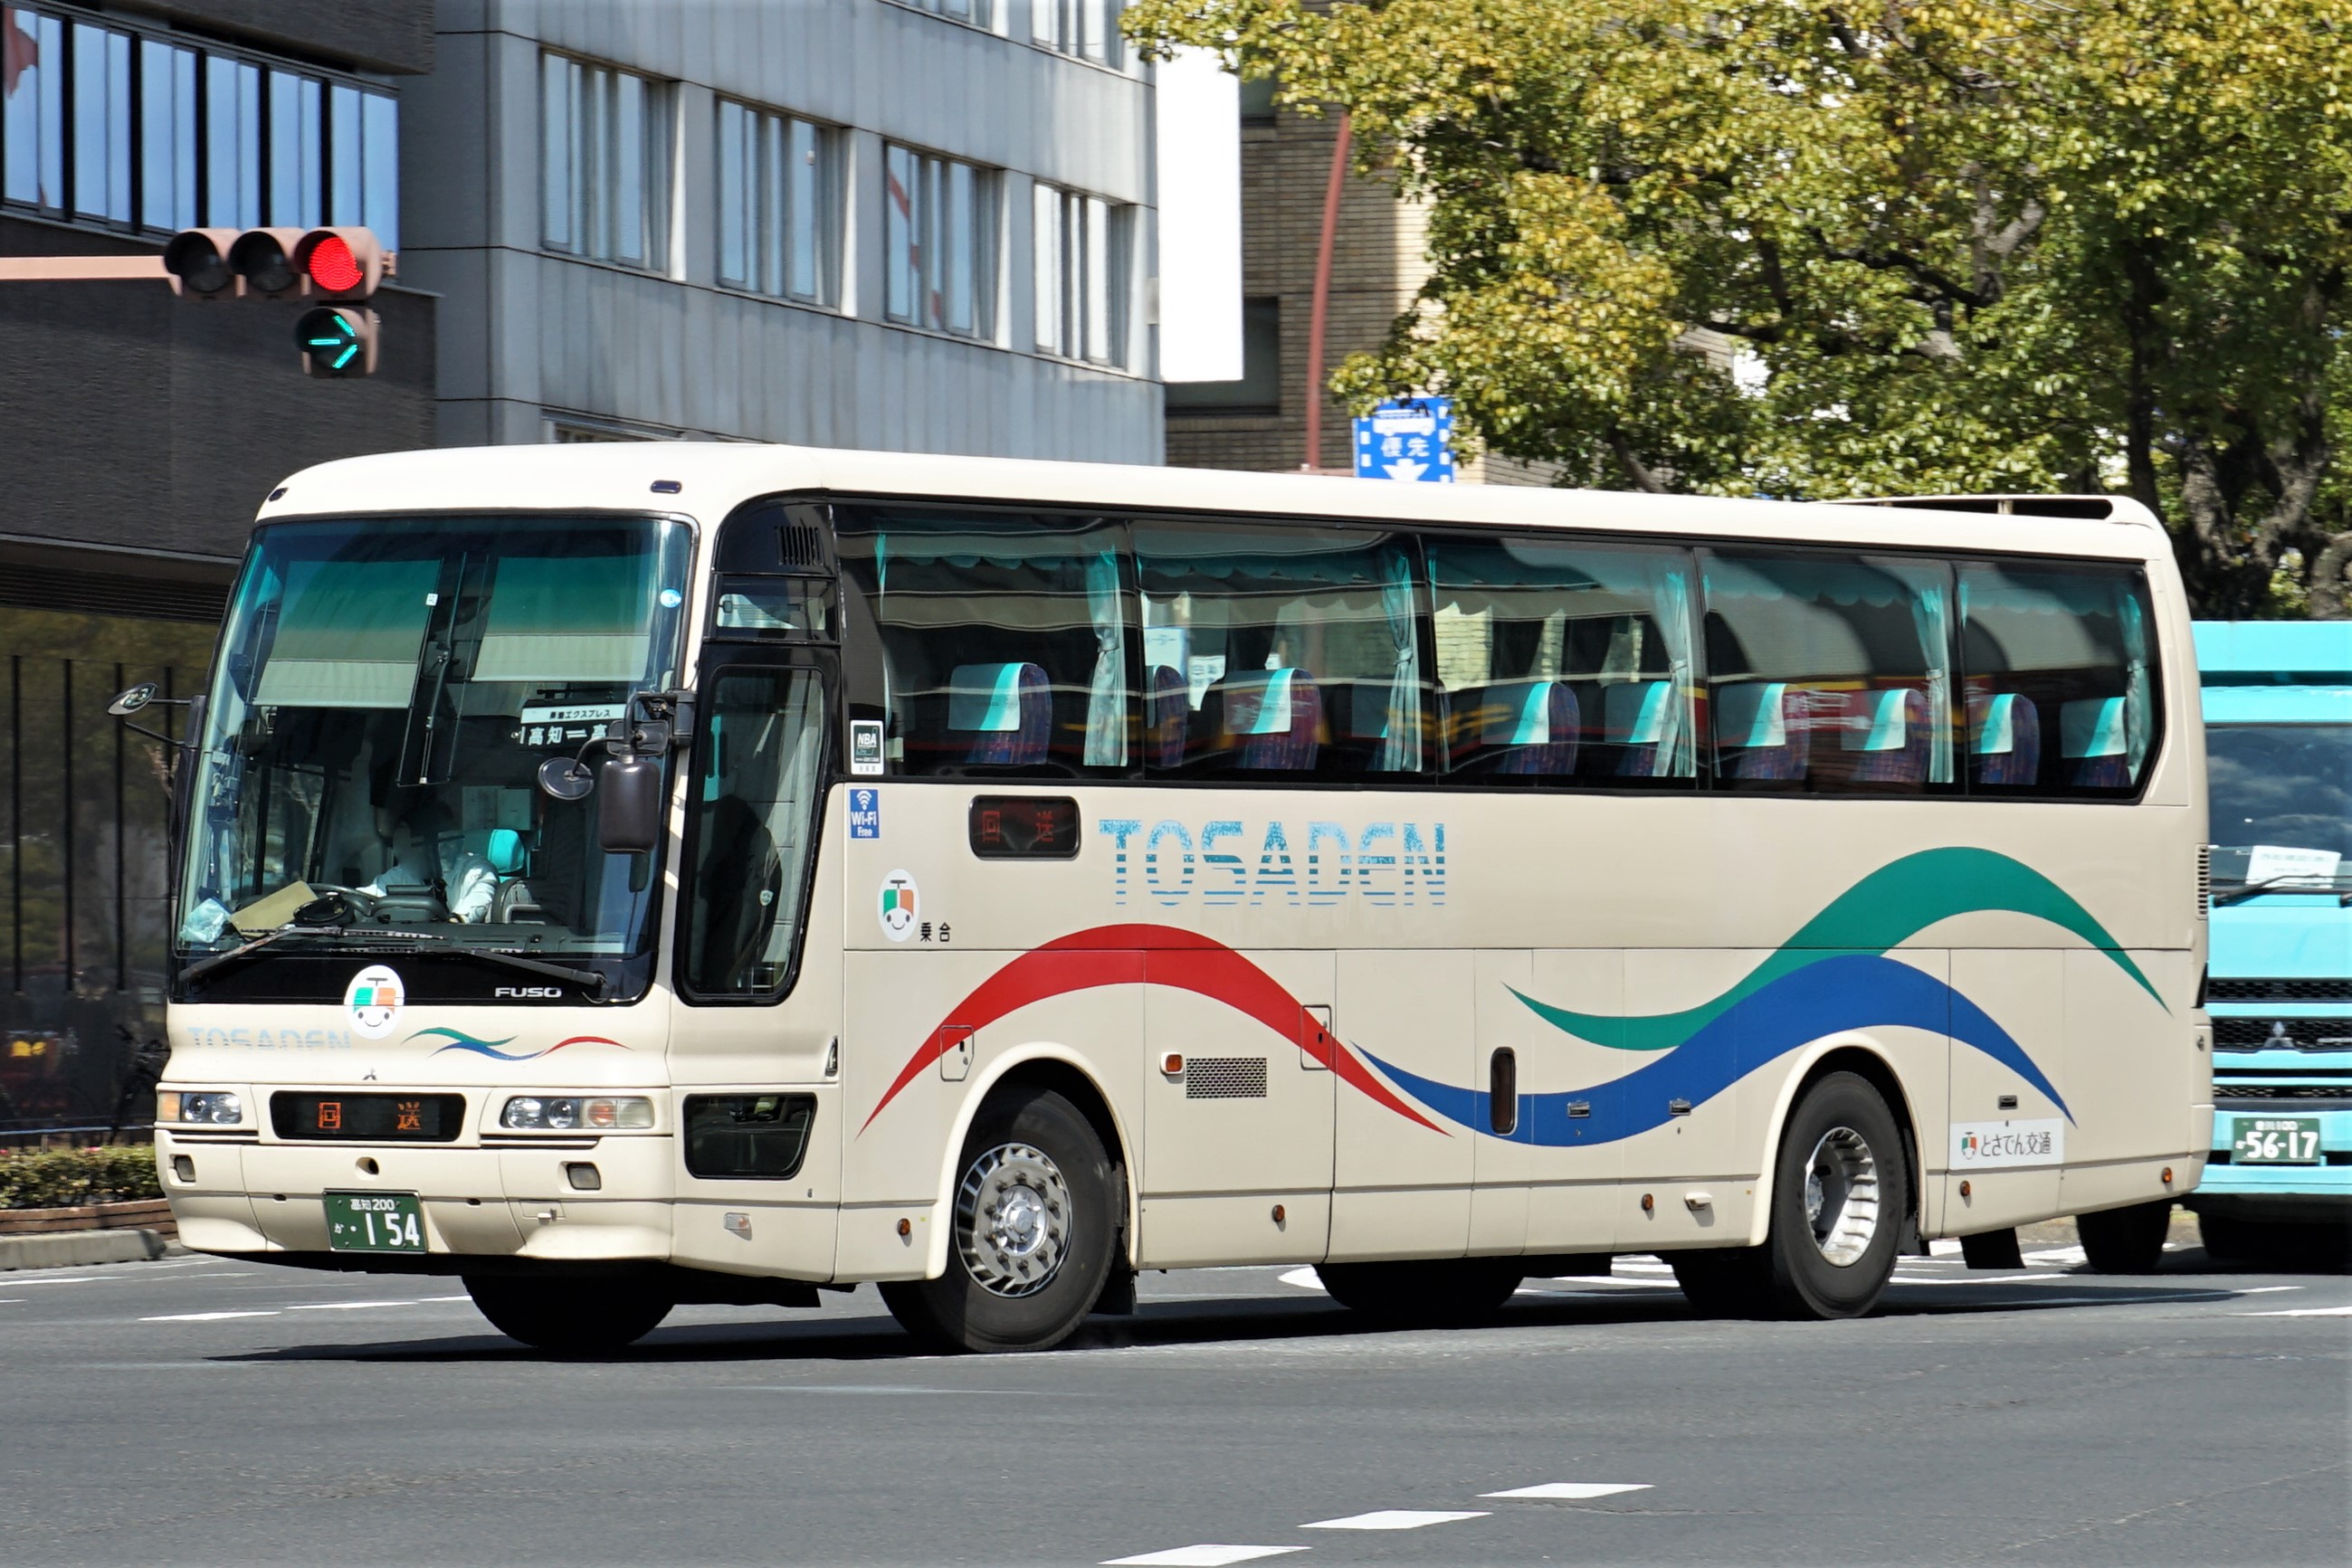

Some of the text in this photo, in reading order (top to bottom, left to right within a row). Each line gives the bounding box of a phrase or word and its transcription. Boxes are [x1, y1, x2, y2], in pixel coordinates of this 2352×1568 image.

[1381, 437, 1431, 458] 優先
[857, 733, 877, 746] NBA
[851, 811, 877, 826] Wi-Fi
[857, 826, 873, 837] Free
[1099, 820, 1445, 906] TOSADEN
[495, 987, 562, 998] FUSO
[187, 1027, 352, 1050] TOSADEN
[1981, 1132, 2052, 1156] とさでん交通
[2246, 1131, 2319, 1159] 56-17
